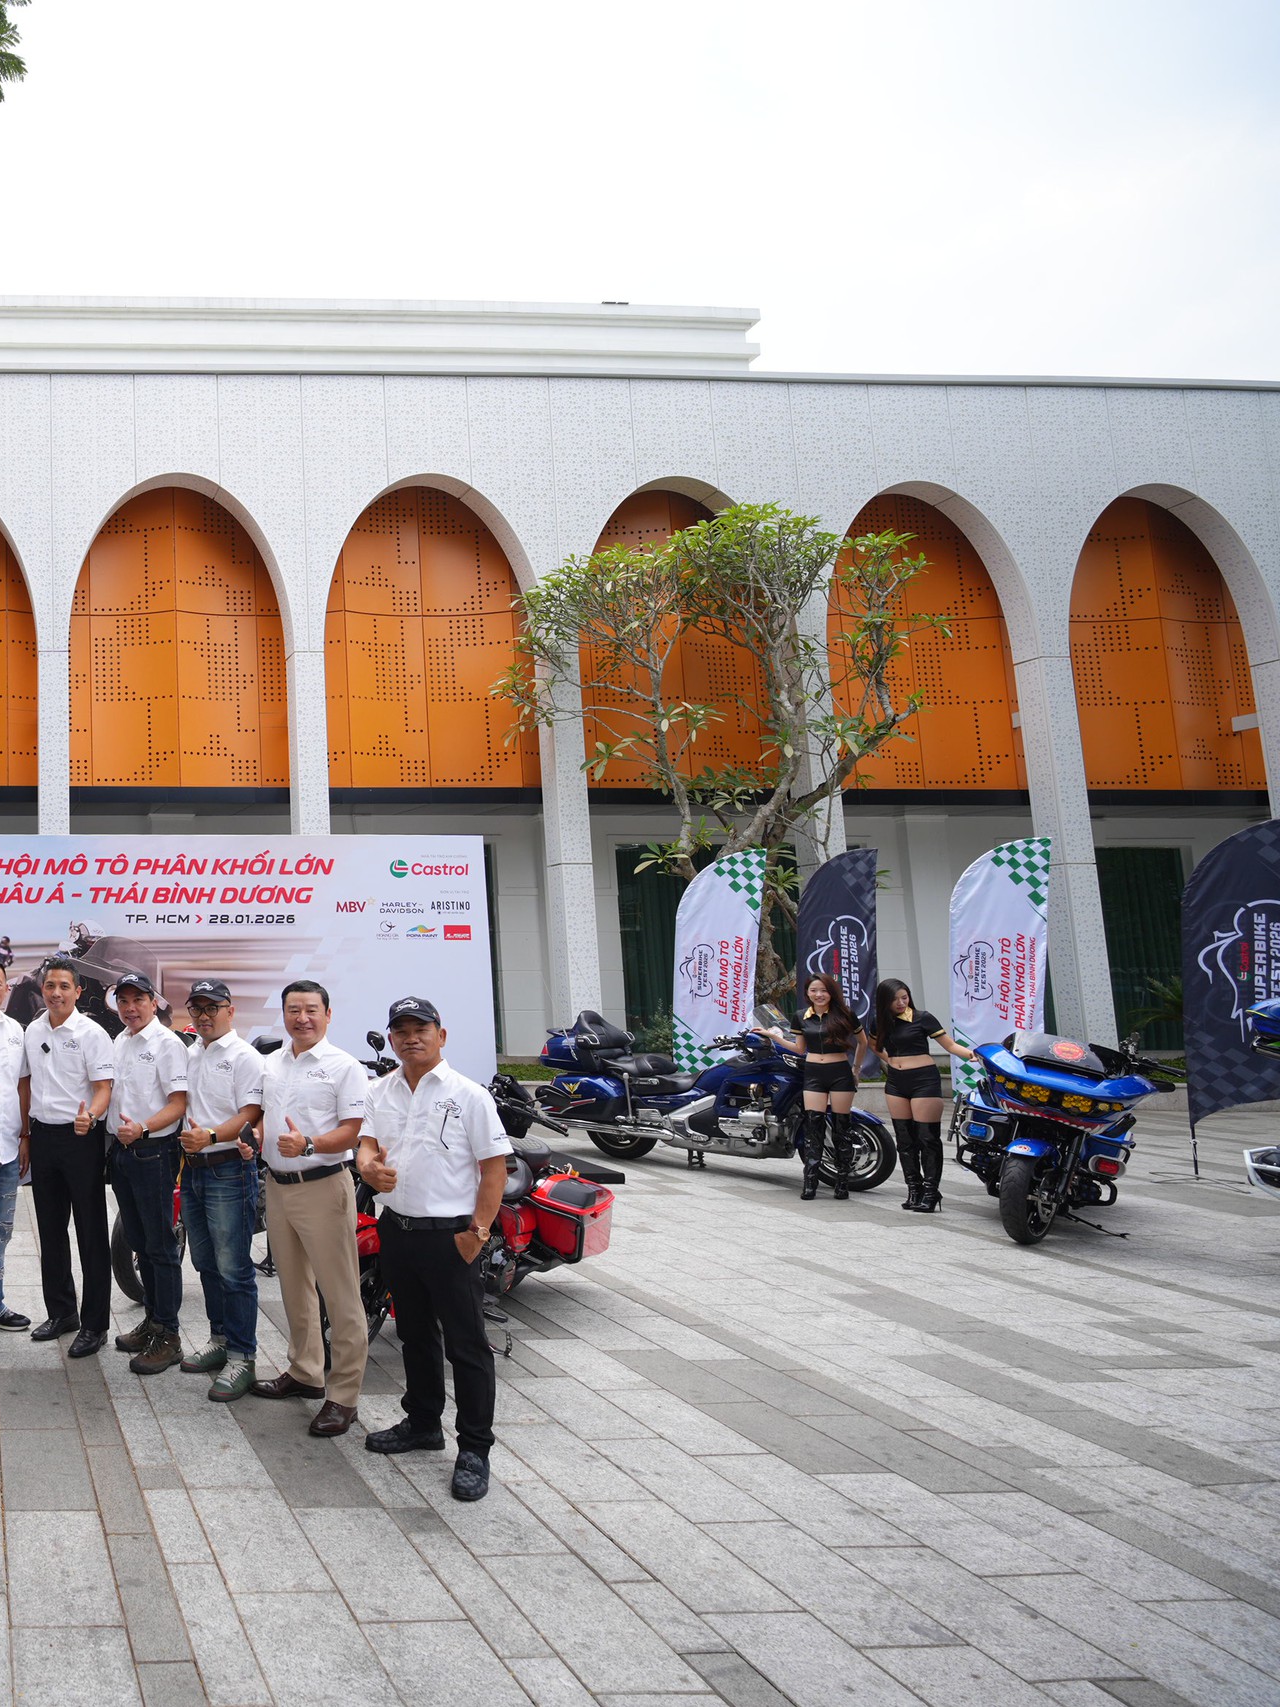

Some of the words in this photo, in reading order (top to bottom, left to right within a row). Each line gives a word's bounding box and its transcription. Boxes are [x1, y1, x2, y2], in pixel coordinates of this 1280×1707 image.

[43, 853, 88, 875] MÔ
[94, 853, 129, 875] TÔ
[133, 853, 208, 875] PHÂN
[211, 850, 276, 875] KHỐI
[278, 853, 334, 875] LỚN
[411, 863, 469, 876] Castrol
[45, 882, 65, 904] Á
[89, 882, 148, 904] THÁI
[152, 882, 216, 904] BÌNH
[220, 884, 314, 904] DƯƠNG
[336, 902, 367, 913] MBV
[431, 901, 470, 911] ARISTINO
[125, 914, 149, 924] TP.
[156, 914, 190, 924] HCM
[208, 914, 296, 924] 28.01.2026
[718, 940, 730, 956] TÔ
[732, 936, 745, 960] LỚN
[849, 934, 858, 963] 2026
[998, 937, 1011, 954] TÔ
[1014, 933, 1026, 961] LỚN
[1270, 922, 1280, 957] 2026
[718, 958, 729, 978] MÔ
[998, 958, 1011, 980] MÔ
[1254, 913, 1267, 1003] UPERBIKE
[730, 961, 743, 988] KHỐI
[850, 965, 860, 1001] FEST
[1012, 962, 1026, 993] KHỐI
[717, 979, 730, 1000] HỘI
[998, 980, 1012, 1003] HỘI
[714, 999, 728, 1015] LỄ
[730, 990, 740, 1023] PHÂN
[995, 1003, 1008, 1021] LỄ
[1011, 994, 1026, 1030] PHÂN
